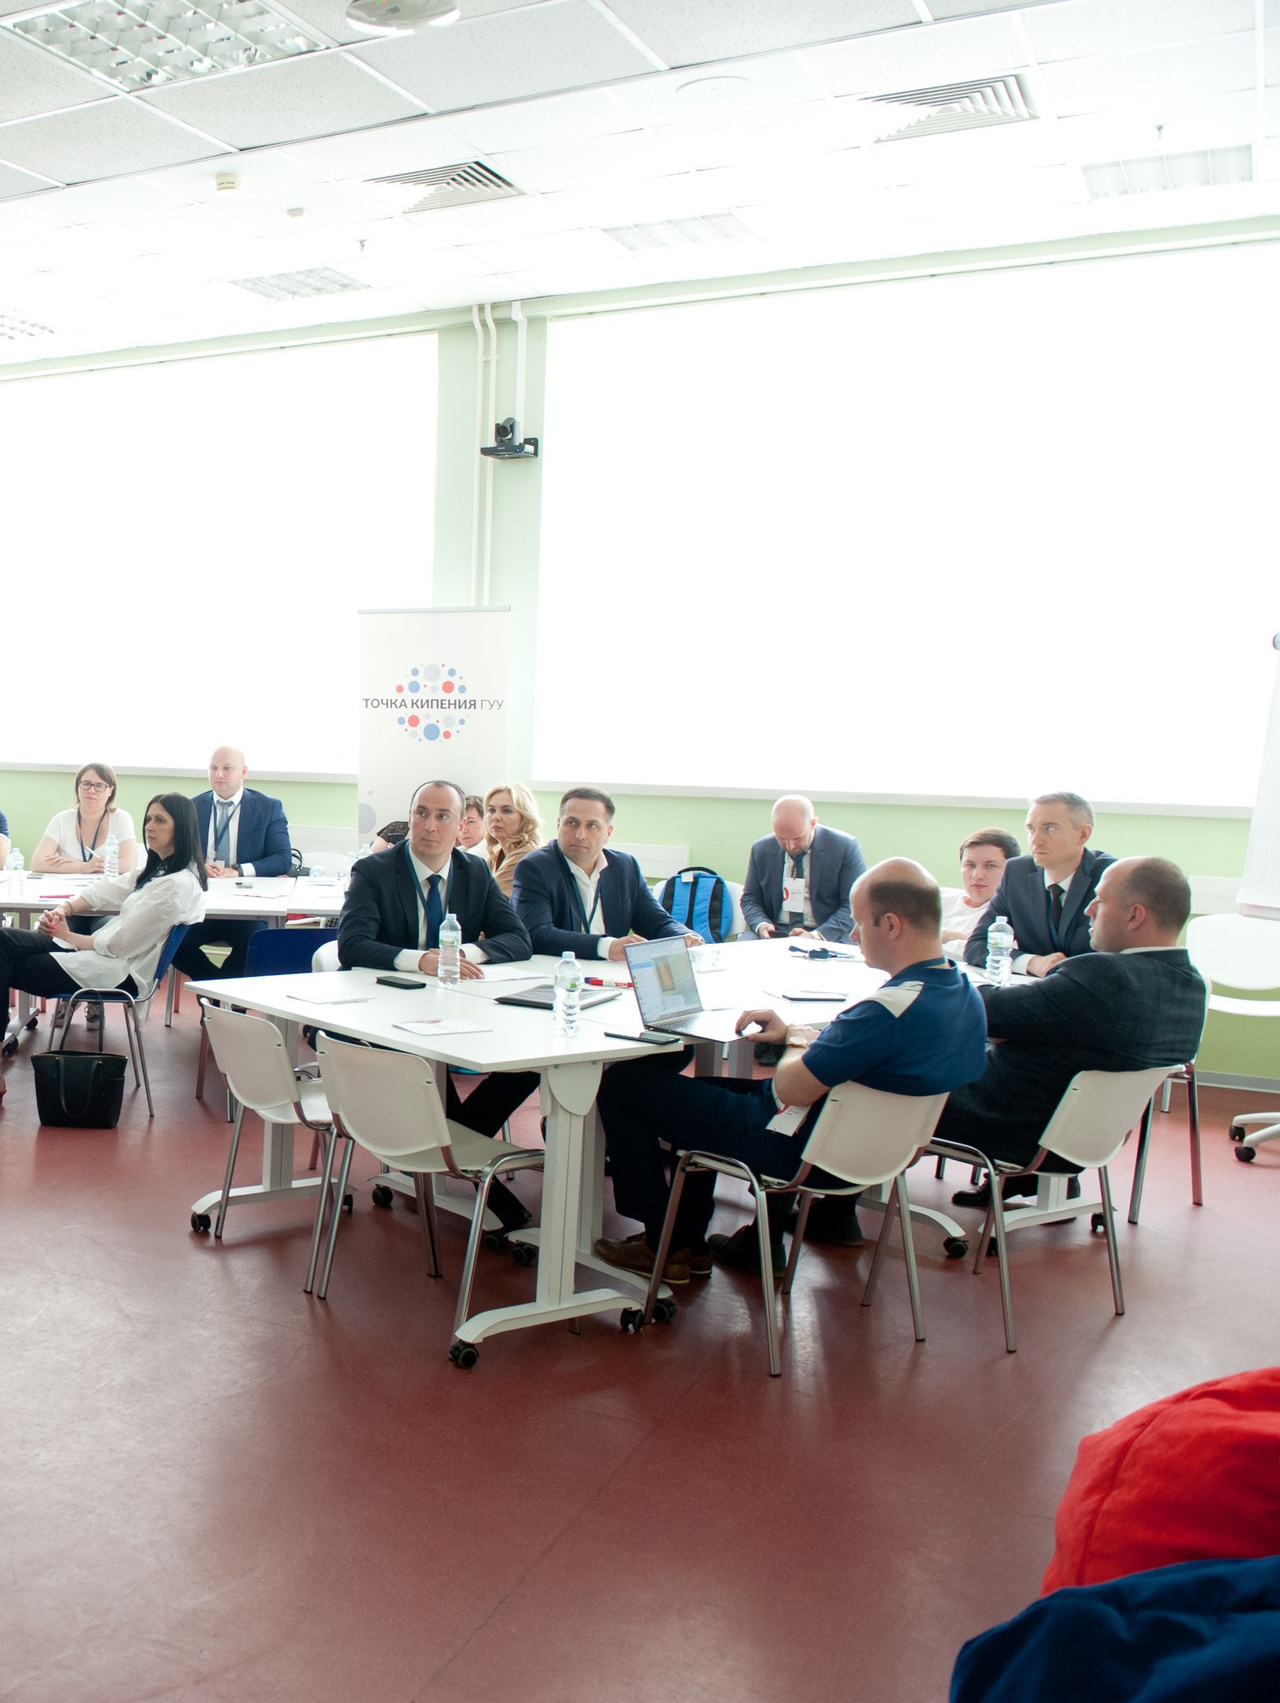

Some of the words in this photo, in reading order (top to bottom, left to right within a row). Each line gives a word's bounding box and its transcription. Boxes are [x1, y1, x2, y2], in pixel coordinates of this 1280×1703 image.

[363, 698, 408, 709] ТОЧКА
[411, 698, 477, 709] КИПЕНИЯ
[480, 699, 504, 710] ГУУ
